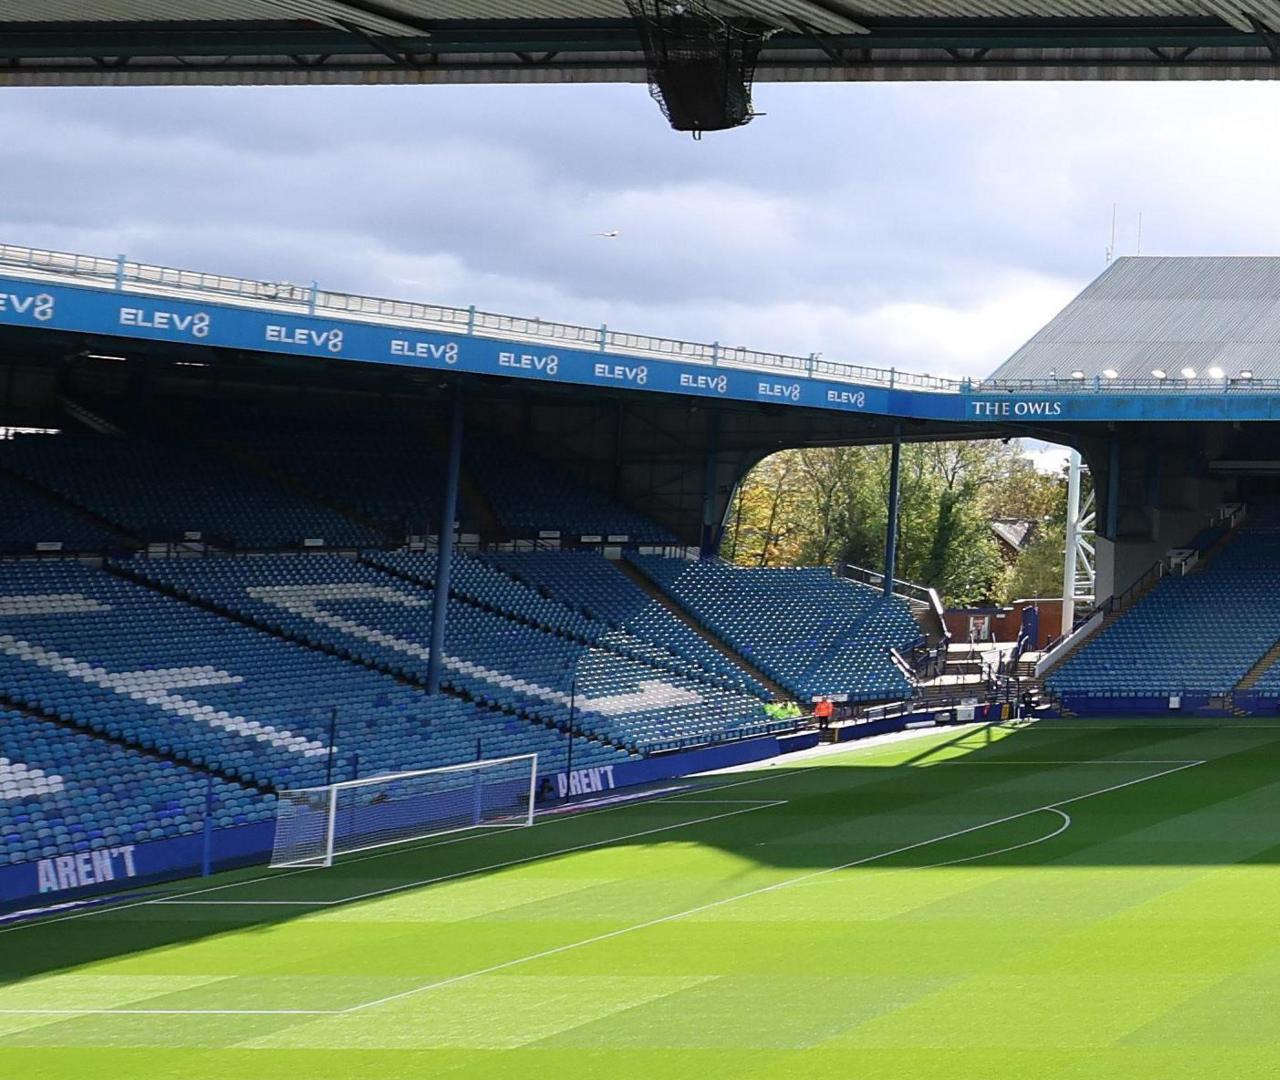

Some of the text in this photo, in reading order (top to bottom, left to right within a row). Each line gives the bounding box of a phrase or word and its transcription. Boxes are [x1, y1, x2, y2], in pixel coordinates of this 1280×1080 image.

[120, 307, 210, 337] ELEV8
[265, 324, 343, 352] ELEV8
[390, 340, 458, 364] ELEV8
[498, 352, 559, 375] ELEV8
[594, 364, 648, 385] ELEV8
[680, 374, 727, 393] ELEV8
[758, 383, 800, 401] ELEV8
[827, 391, 865, 408] ELEV8
[972, 401, 1062, 416] THE OWLS
[37, 844, 136, 893] AREN'T
